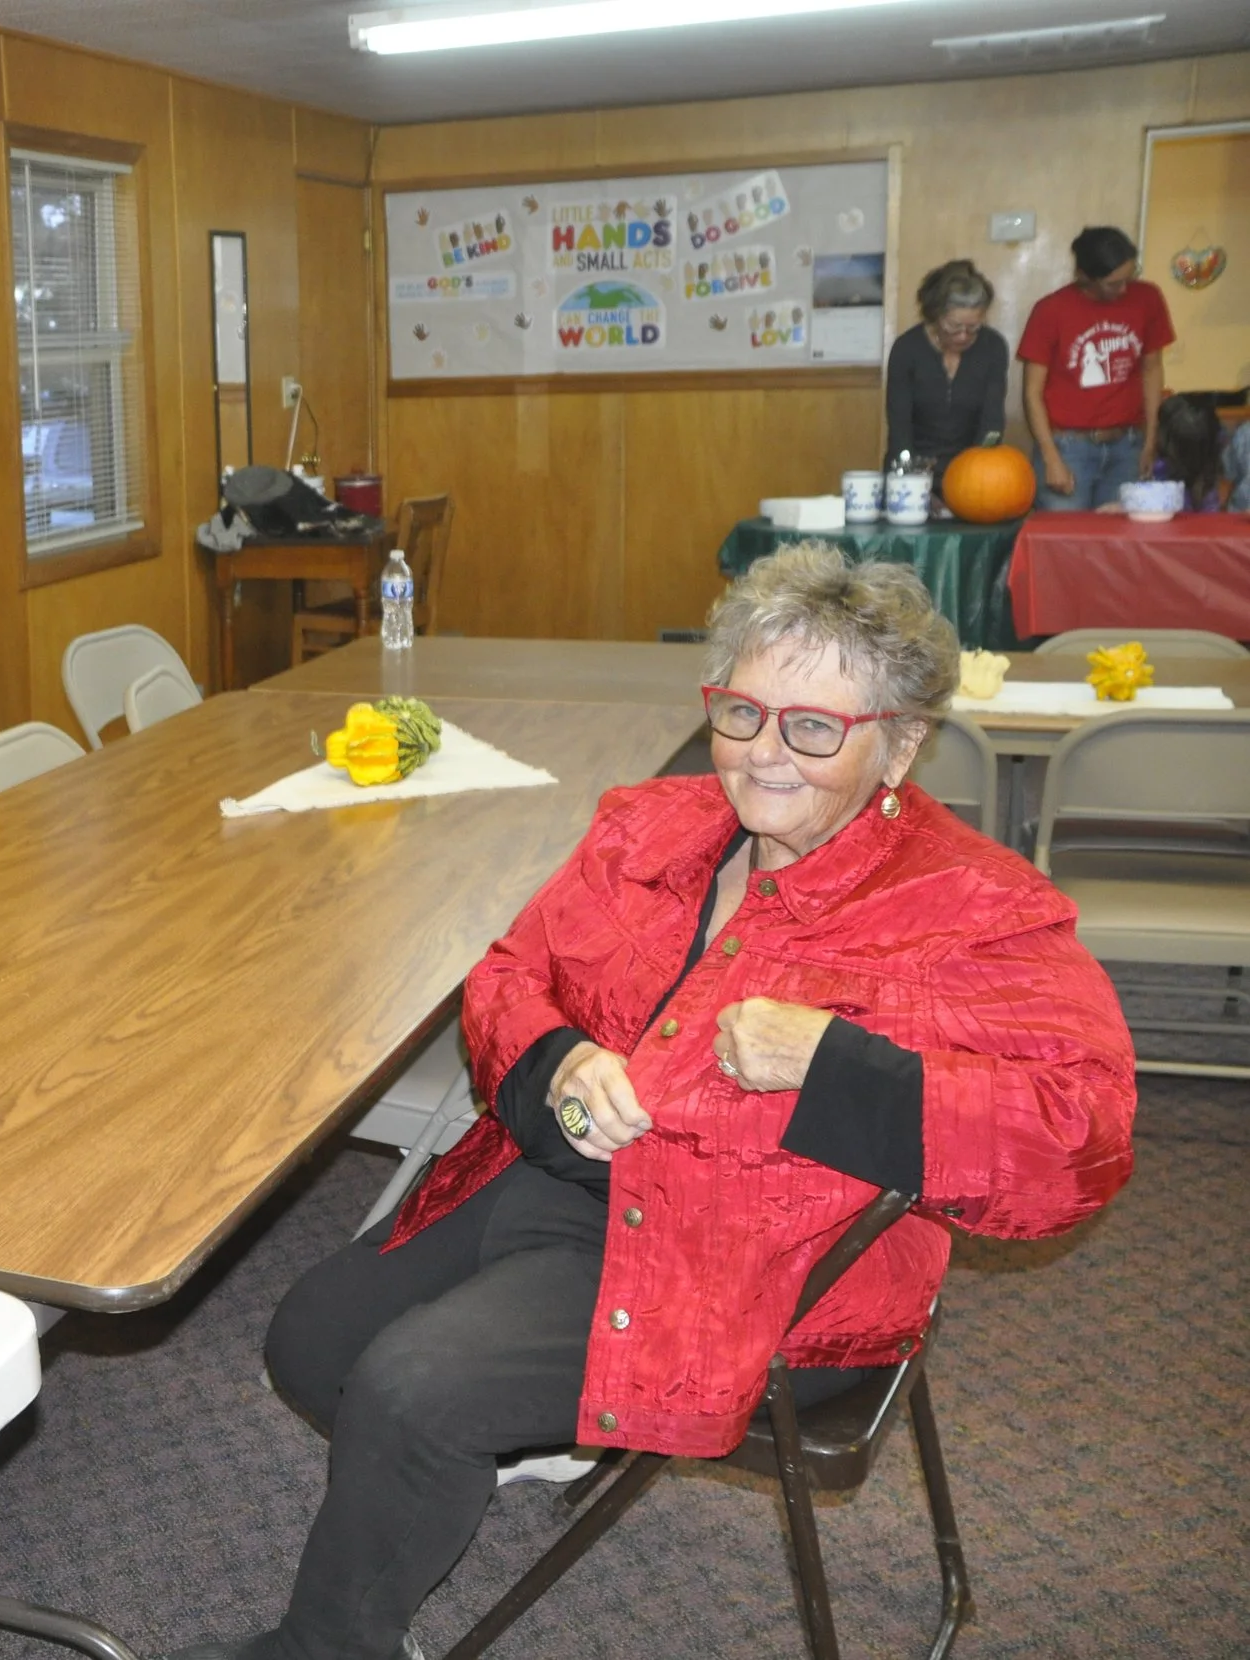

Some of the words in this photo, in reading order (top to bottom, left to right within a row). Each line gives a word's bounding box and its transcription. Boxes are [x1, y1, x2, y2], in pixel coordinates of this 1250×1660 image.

[553, 205, 594, 223] LITTLE
[690, 225, 721, 250] DO
[725, 196, 786, 234] GOOD
[466, 233, 511, 260] KIND
[552, 219, 672, 252] HANDS
[577, 251, 628, 272] SMALL
[633, 250, 672, 269] ACTS
[684, 269, 771, 300] FORGIVE
[588, 311, 630, 325] CHANGE
[558, 324, 660, 347] WORLD
[751, 326, 804, 349] LOVE
